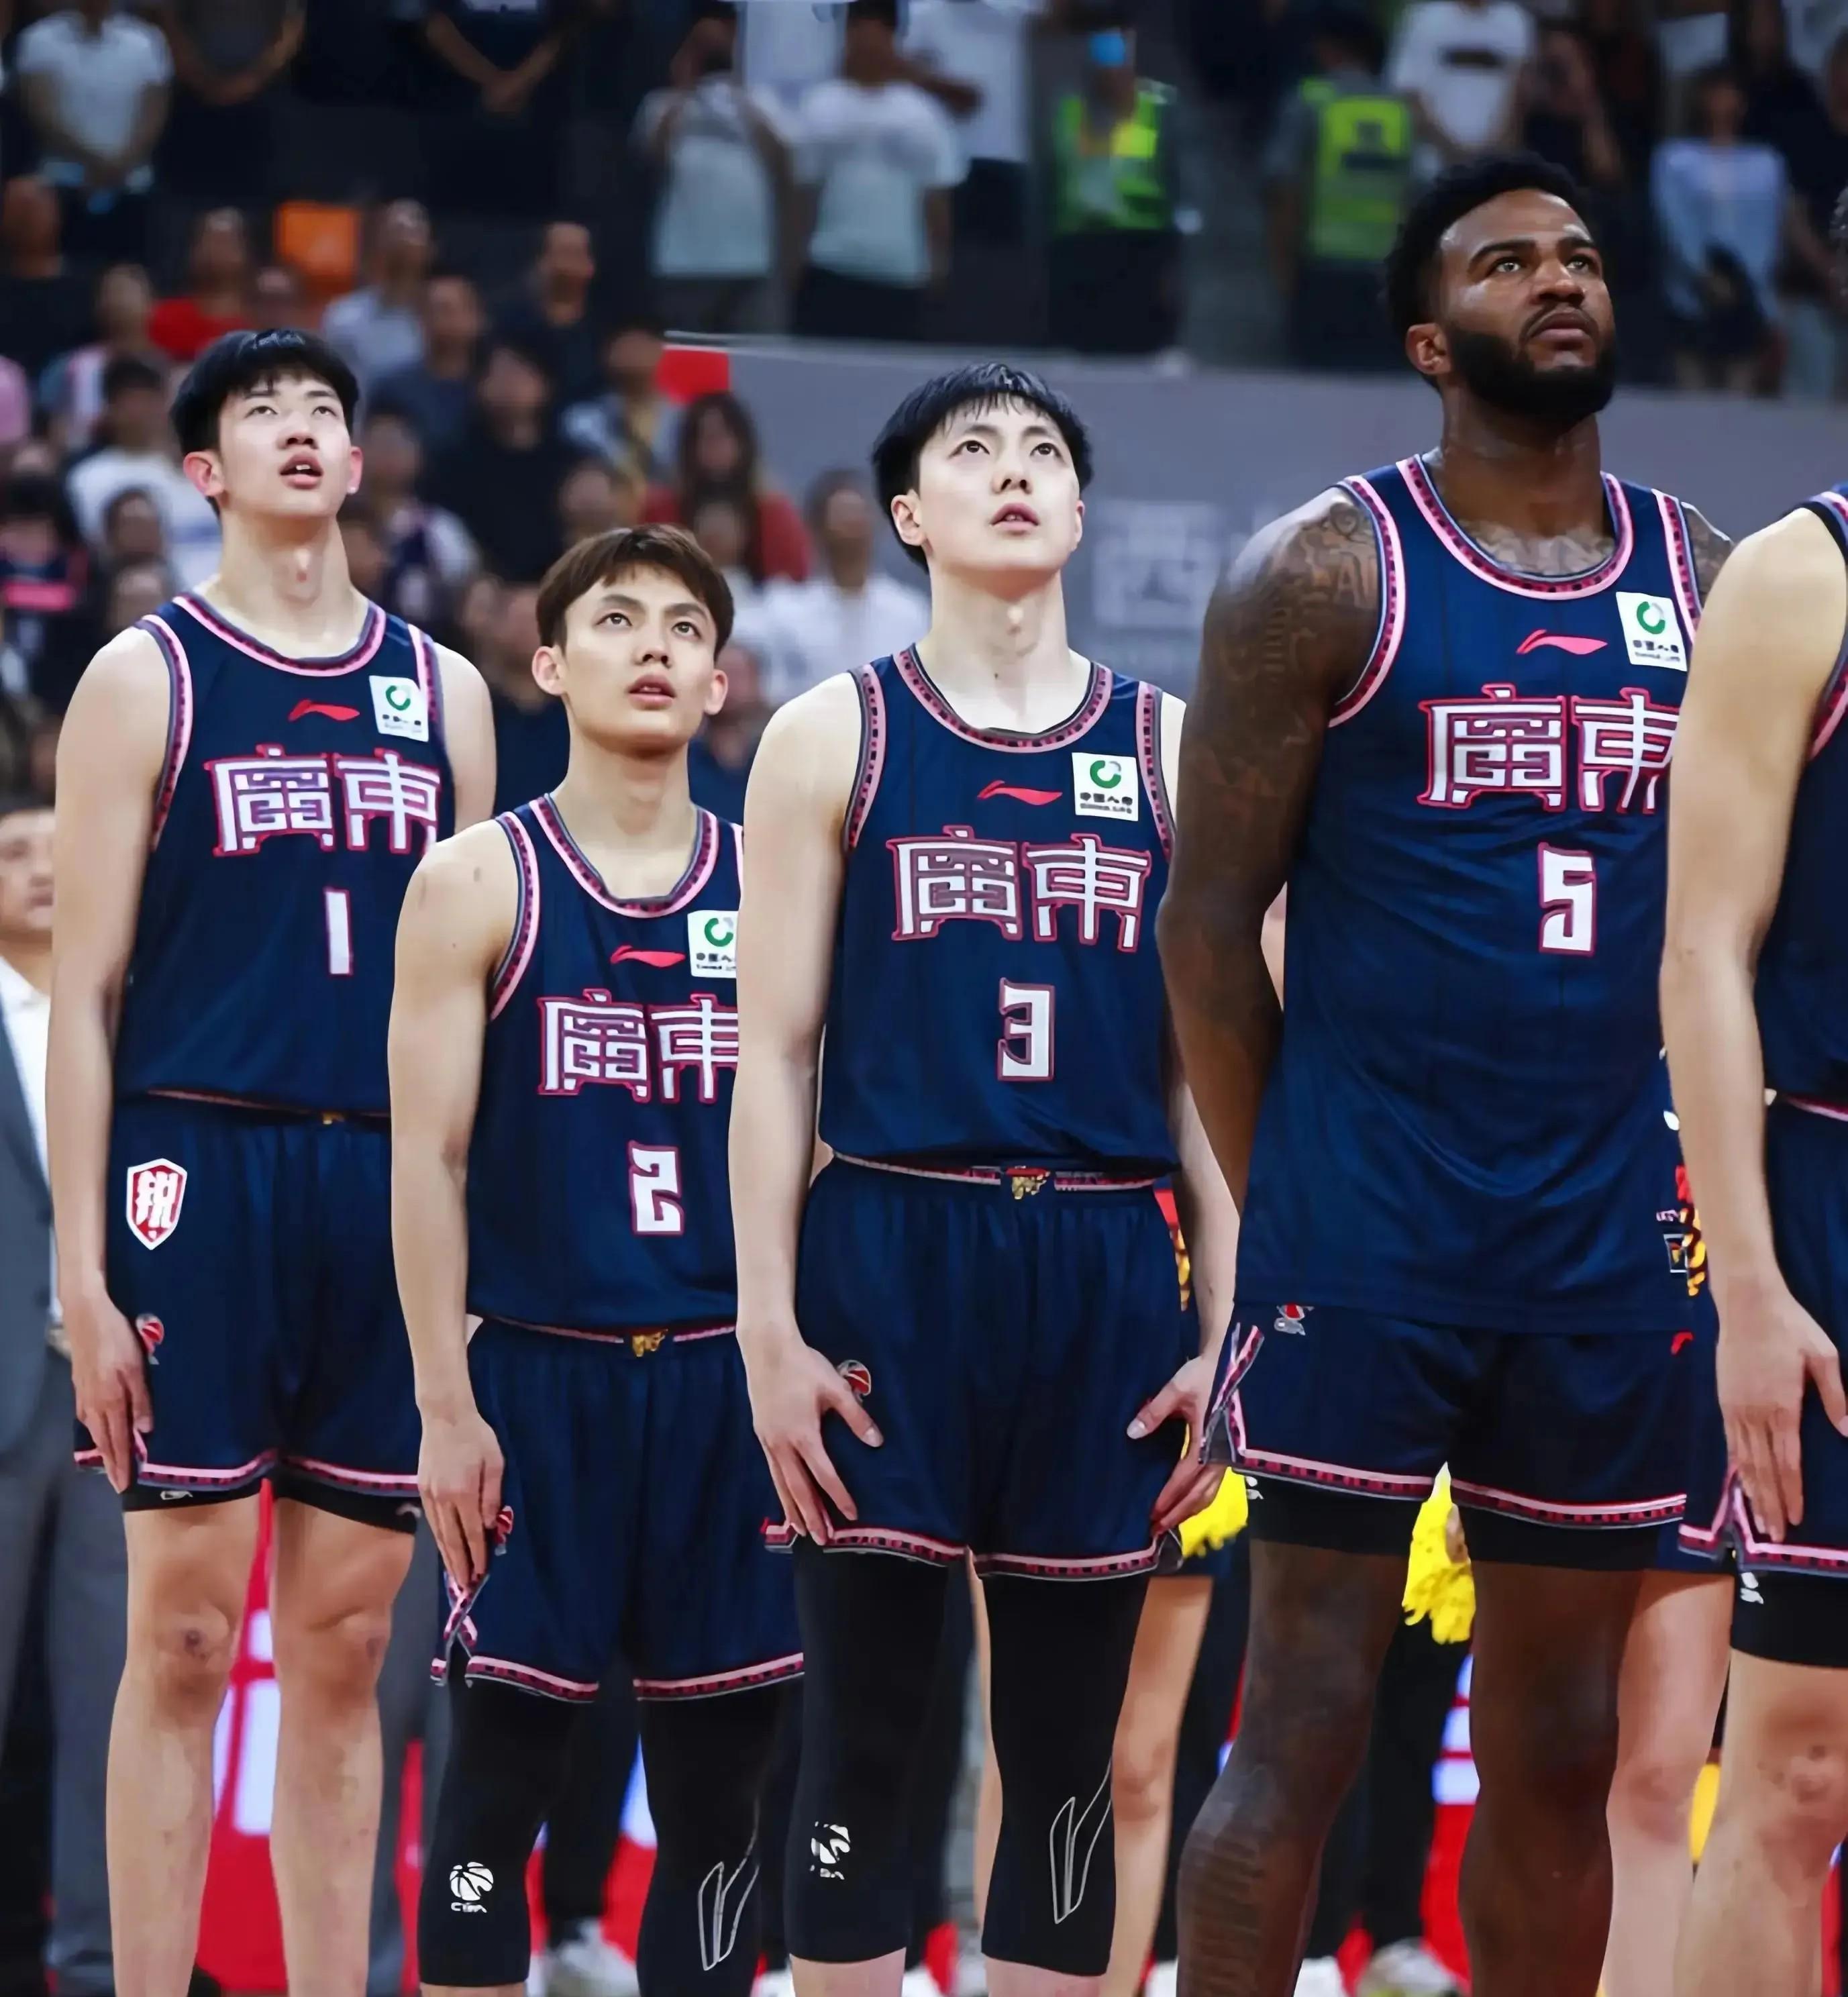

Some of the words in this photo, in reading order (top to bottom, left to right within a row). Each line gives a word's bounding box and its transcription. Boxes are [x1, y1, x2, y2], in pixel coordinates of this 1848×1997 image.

[323, 886, 354, 976] 1
[886, 825, 1151, 953] 廣東
[1538, 841, 1597, 956] 5
[997, 976, 1056, 1082] 3
[627, 1140, 685, 1236] 2
